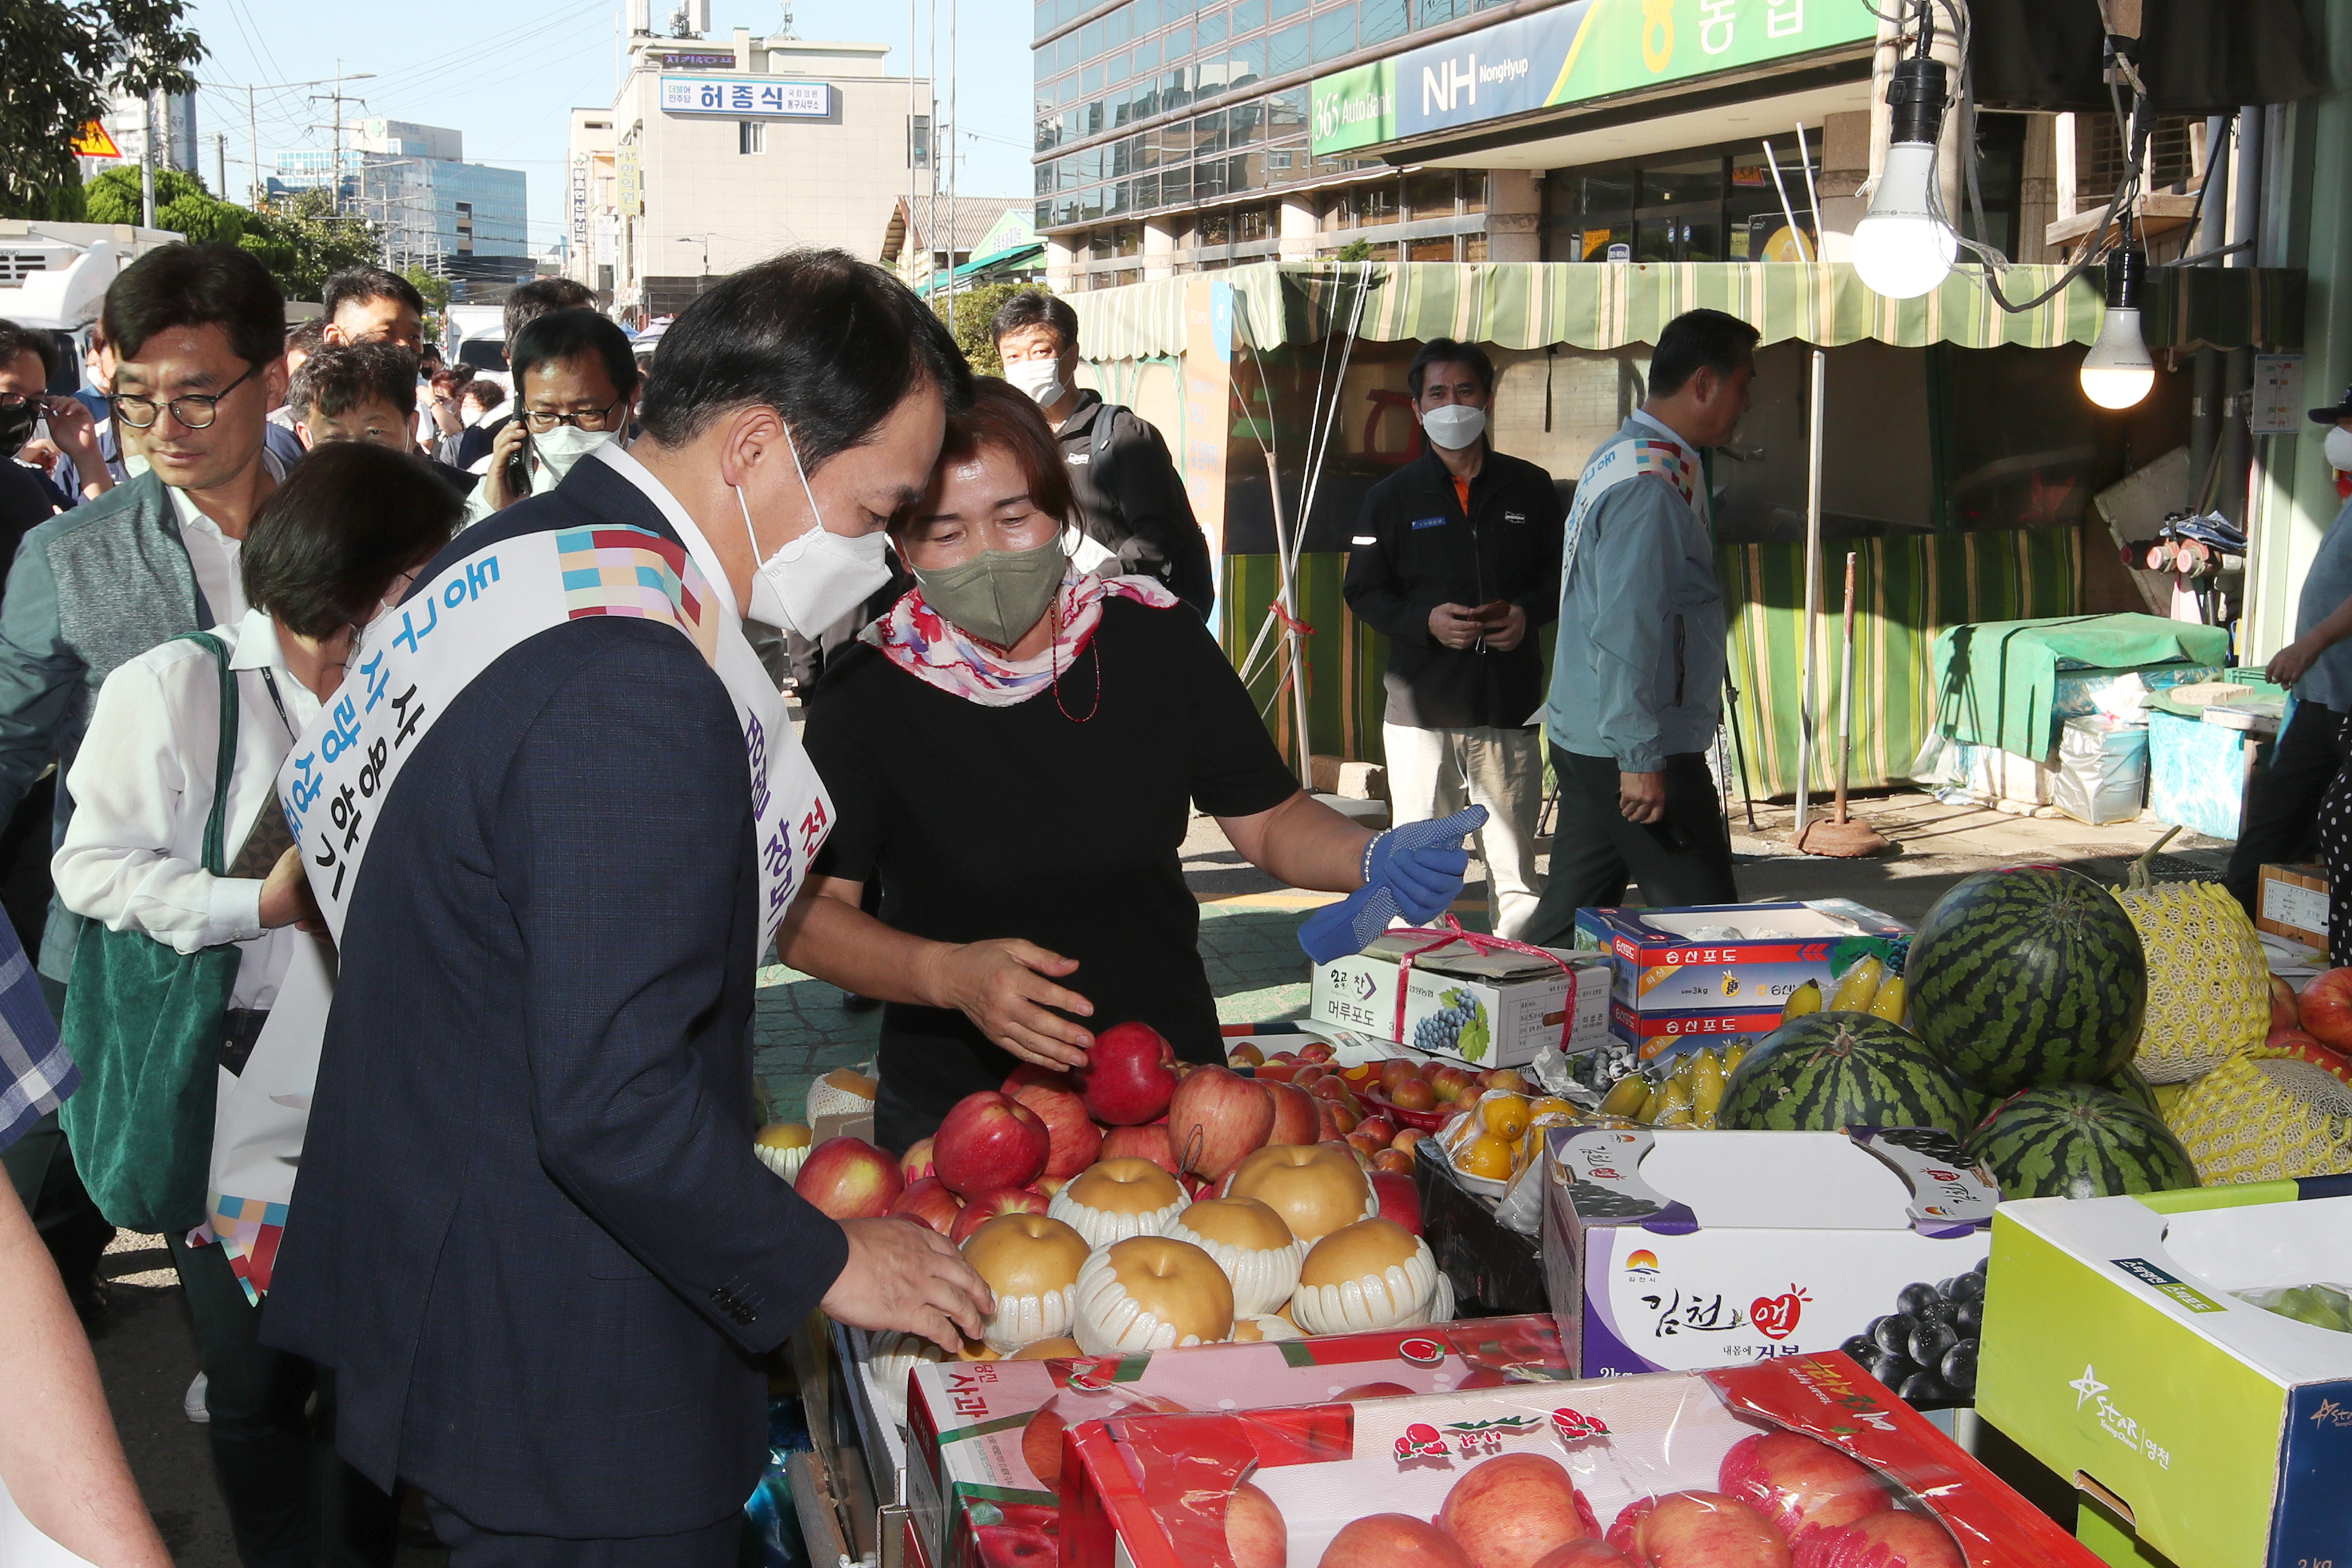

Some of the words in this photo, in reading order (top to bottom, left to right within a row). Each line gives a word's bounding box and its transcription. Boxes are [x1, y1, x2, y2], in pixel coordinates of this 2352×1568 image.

[669, 85, 690, 94] 더불어
[1423, 53, 1476, 116] NH
[1479, 58, 1528, 84] NongHyup
[669, 95, 691, 103] 민주당
[788, 89, 818, 98] 국회의원
[787, 99, 819, 110] 동구사무소
[1315, 92, 1340, 141] 365
[1665, 949, 1736, 964] 송산포도
[1771, 984, 1796, 995] 송산
[1329, 1000, 1375, 1027] 머루포도
[1666, 1018, 1735, 1033] 송산포도
[1641, 1287, 1722, 1337] 김천
[1723, 1345, 1752, 1357] 내몸에
[974, 1364, 998, 1384] 당진
[946, 1373, 989, 1418] 사과
[2145, 1439, 2170, 1470] 영천
